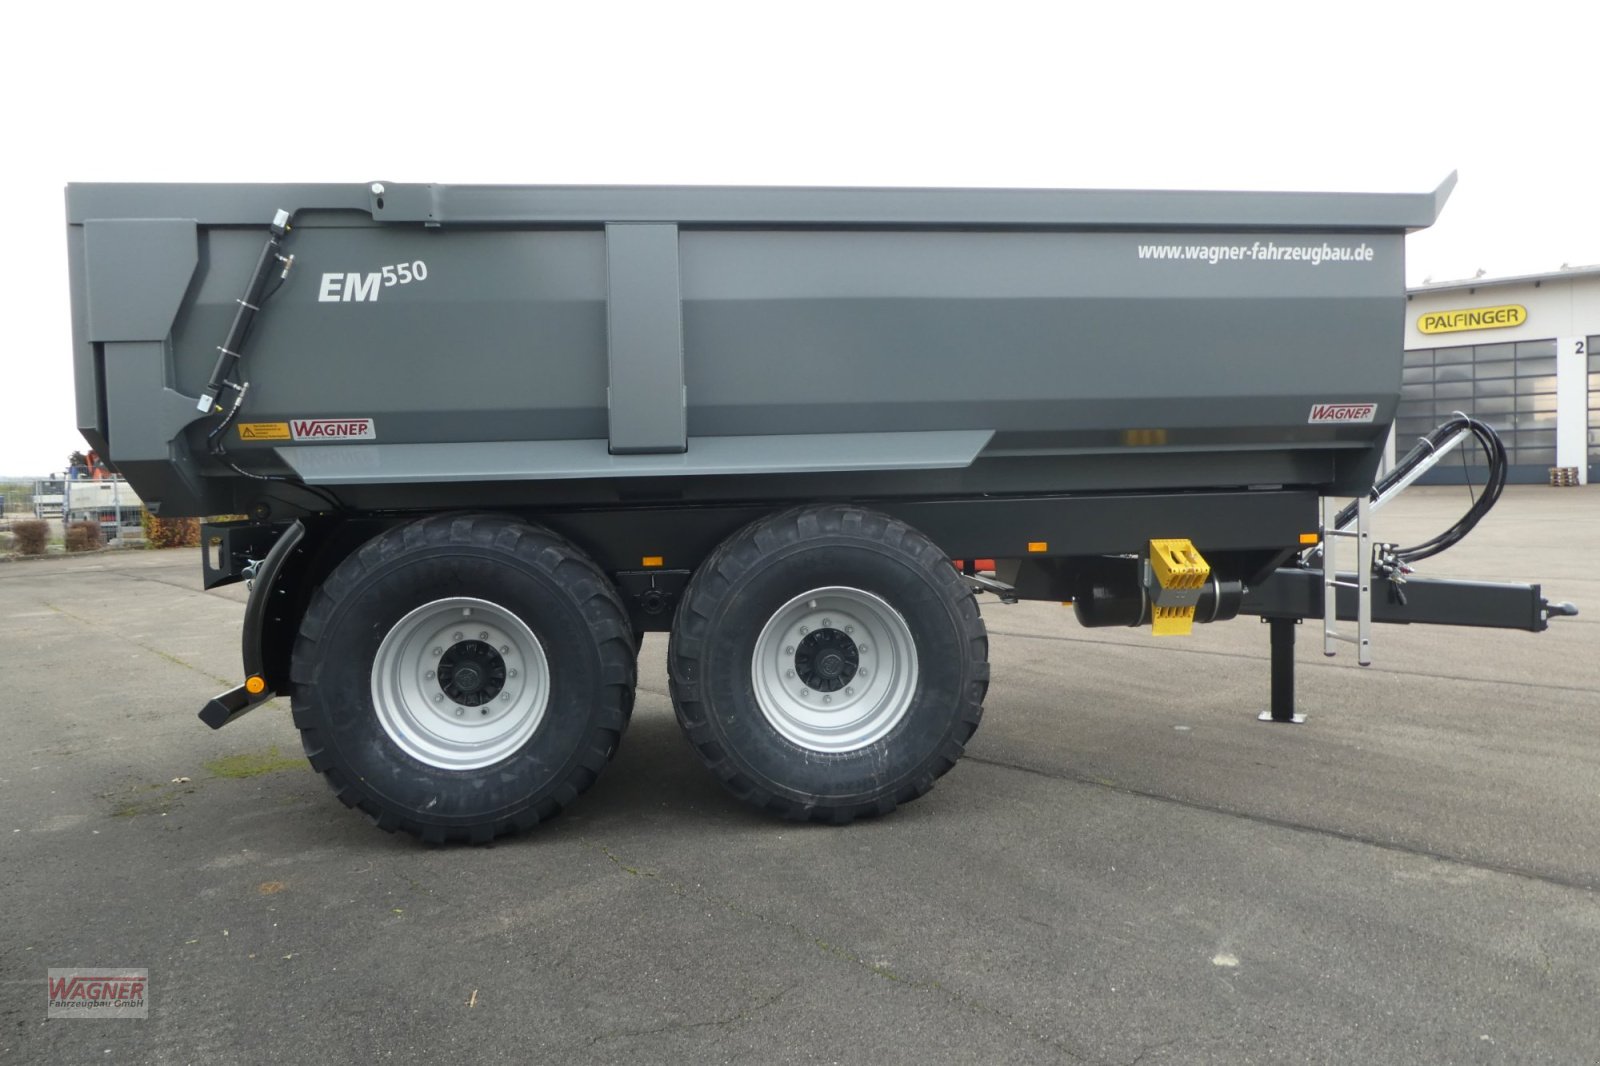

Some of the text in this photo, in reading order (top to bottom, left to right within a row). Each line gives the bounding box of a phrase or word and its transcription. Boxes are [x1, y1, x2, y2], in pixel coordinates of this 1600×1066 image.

[1138, 242, 1374, 265] www.wagner-fahrzeugbau.de
[1425, 308, 1519, 330] PALFINGER
[1575, 341, 1584, 354] 2
[1312, 405, 1374, 420] WAGNER
[294, 420, 369, 437] WAGNER
